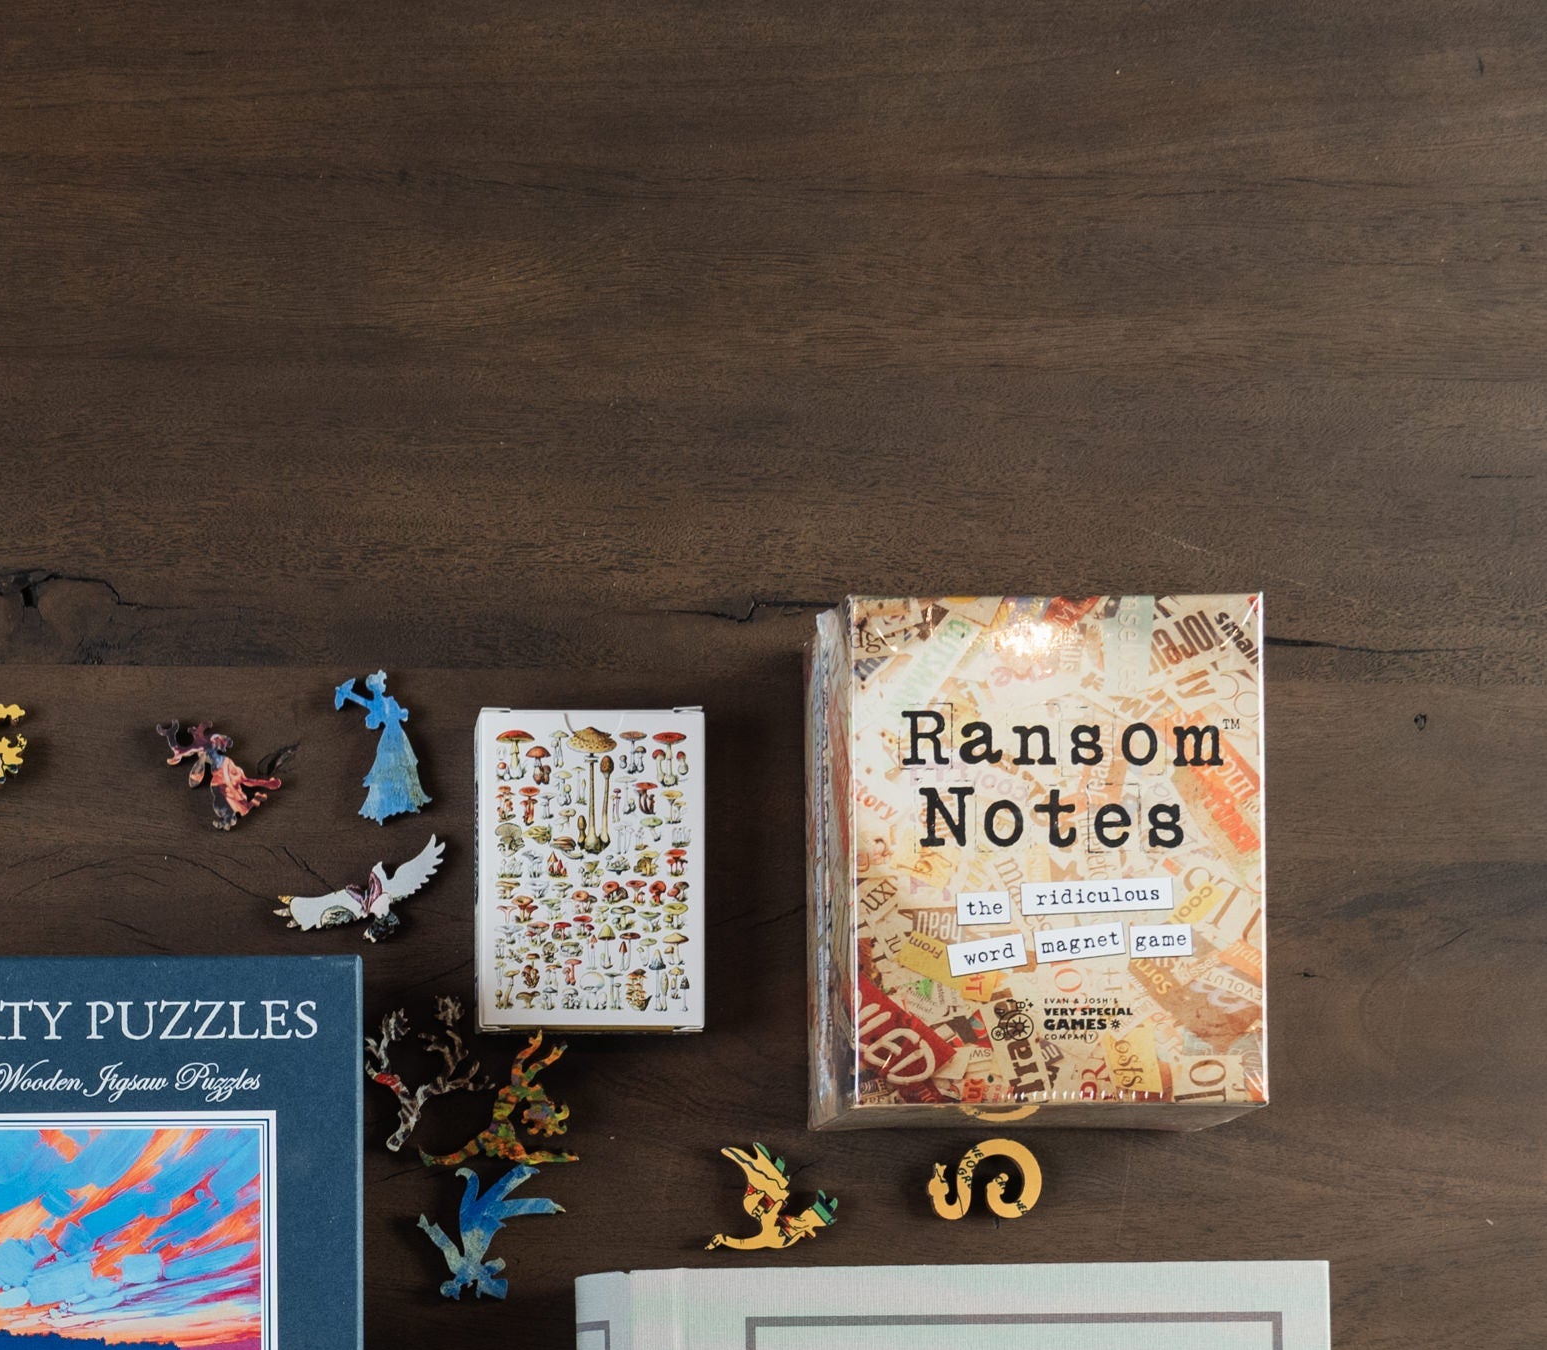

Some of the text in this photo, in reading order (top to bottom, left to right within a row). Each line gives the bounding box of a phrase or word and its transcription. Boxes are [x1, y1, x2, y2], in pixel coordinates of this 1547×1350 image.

[901, 710, 1224, 766] Ransom
[918, 786, 1184, 848] Notes
[966, 886, 1160, 916] the ridiculous
[963, 930, 1188, 967] word magnet game
[85, 999, 319, 1041] PUZZLES
[1043, 1018, 1108, 1031] GAMES
[1044, 1006, 1134, 1017] VERY SPECIAL
[1044, 1033, 1095, 1041] COMPANY
[83, 1061, 168, 1102] Jigsaw
[174, 1062, 261, 1103] Puzzles
